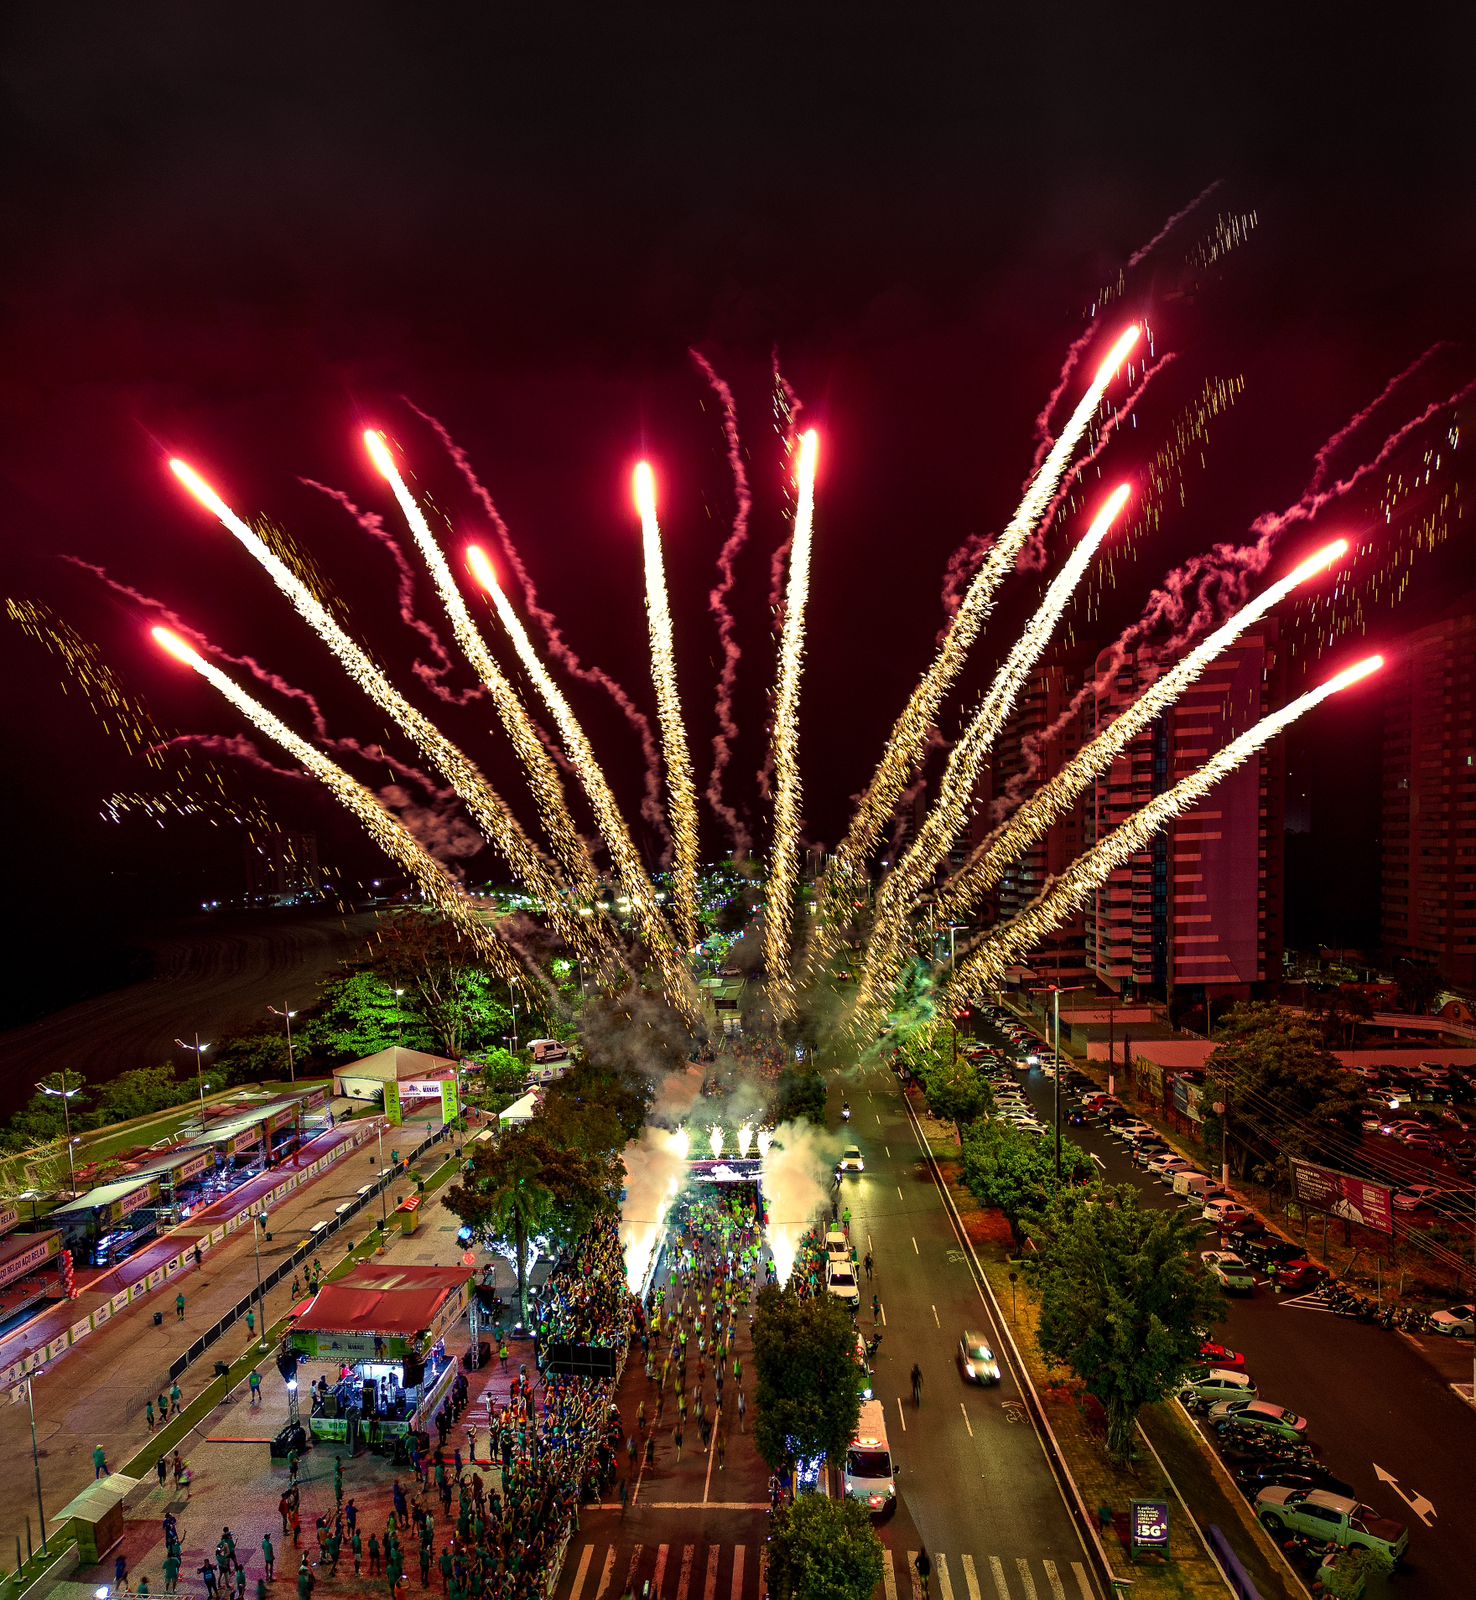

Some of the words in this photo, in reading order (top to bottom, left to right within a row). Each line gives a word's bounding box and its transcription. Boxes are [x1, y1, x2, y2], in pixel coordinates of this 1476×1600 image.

[0, 1211, 15, 1224] RELAX
[31, 1247, 46, 1261] RELAX
[1141, 1525, 1161, 1537] 5G
